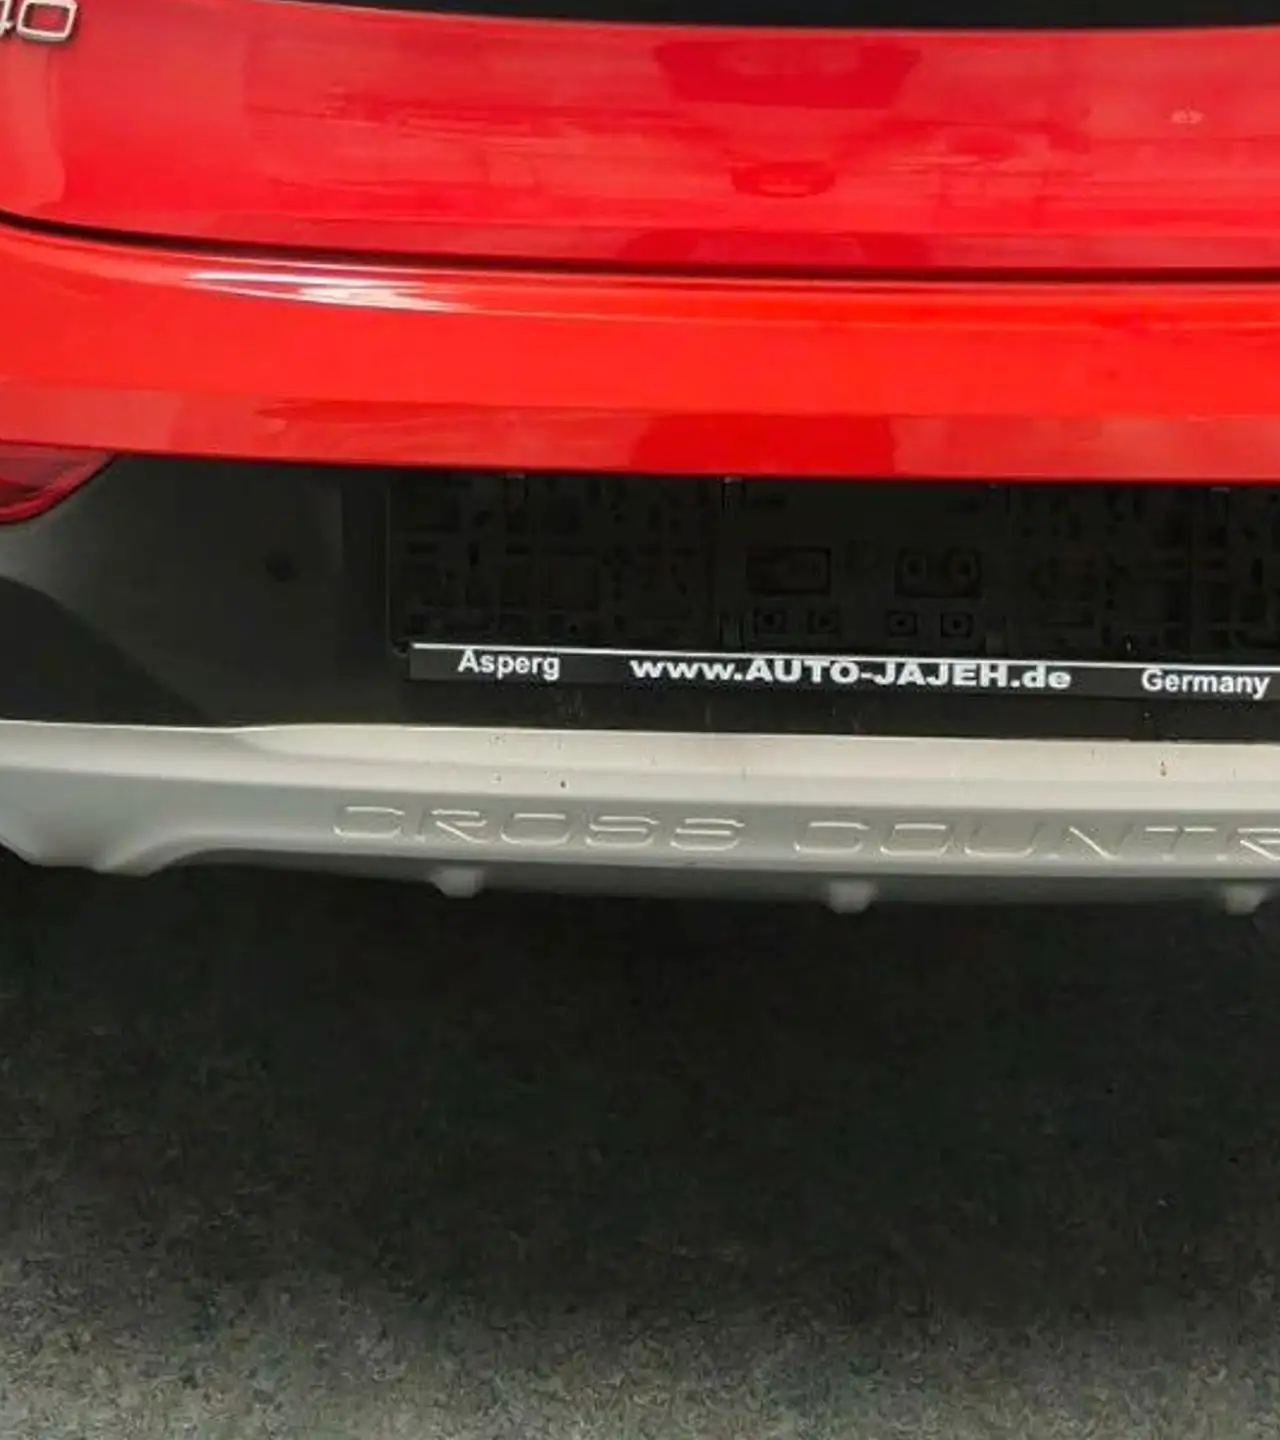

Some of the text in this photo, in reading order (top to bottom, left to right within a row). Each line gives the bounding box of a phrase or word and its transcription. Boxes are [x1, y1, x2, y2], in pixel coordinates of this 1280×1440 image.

[457, 649, 1271, 700] Asperg www.AUTO-JAJEH.de Germany
[333, 806, 746, 852] CROSS
